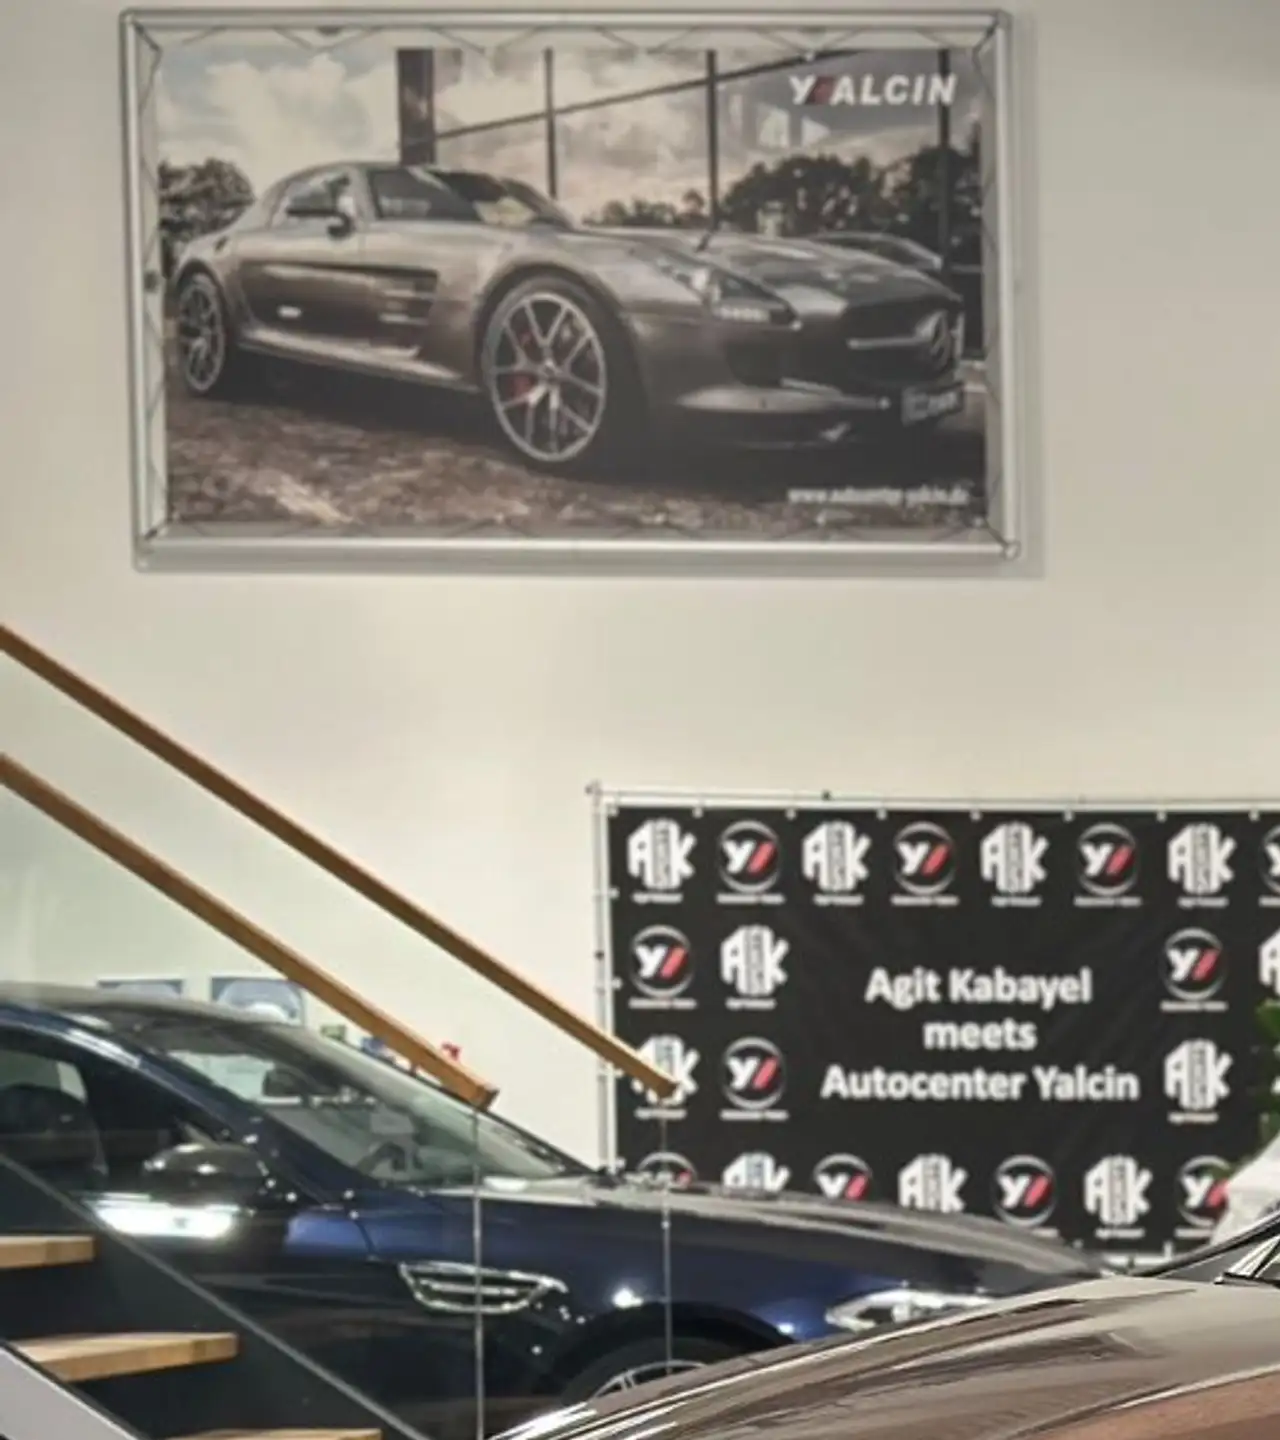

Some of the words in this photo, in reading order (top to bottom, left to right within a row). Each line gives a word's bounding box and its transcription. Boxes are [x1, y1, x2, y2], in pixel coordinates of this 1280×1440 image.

[865, 967, 941, 1010] Agit
[949, 967, 1092, 1010] Kabayel
[923, 1018, 1037, 1050] meets
[821, 1064, 1027, 1100] Autocenter
[1033, 1064, 1139, 1100] Yalcin
